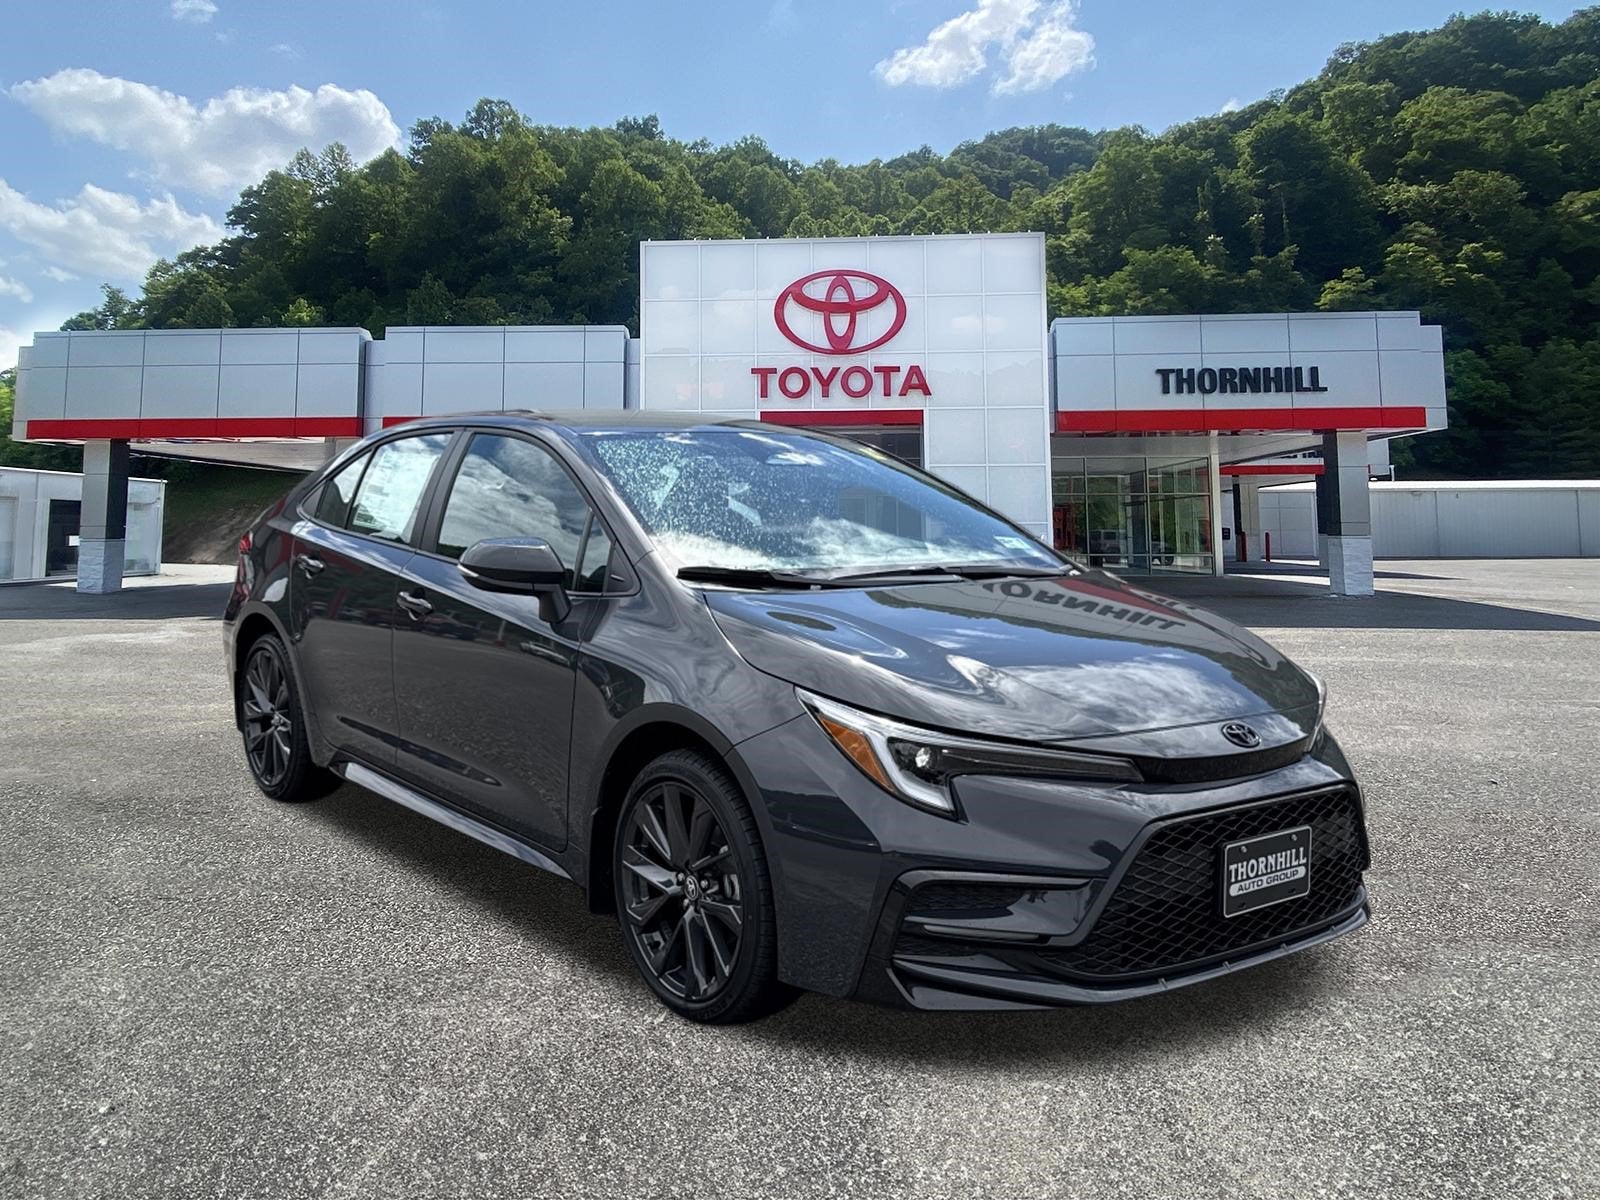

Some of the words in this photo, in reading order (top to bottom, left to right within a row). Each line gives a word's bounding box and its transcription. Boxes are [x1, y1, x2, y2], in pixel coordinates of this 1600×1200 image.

[751, 365, 932, 398] TOYOTA
[1156, 366, 1328, 394] THORNHILL
[1229, 847, 1307, 882] THORNHILL
[1237, 879, 1263, 893] AUTO
[1266, 869, 1298, 884] GROUP
